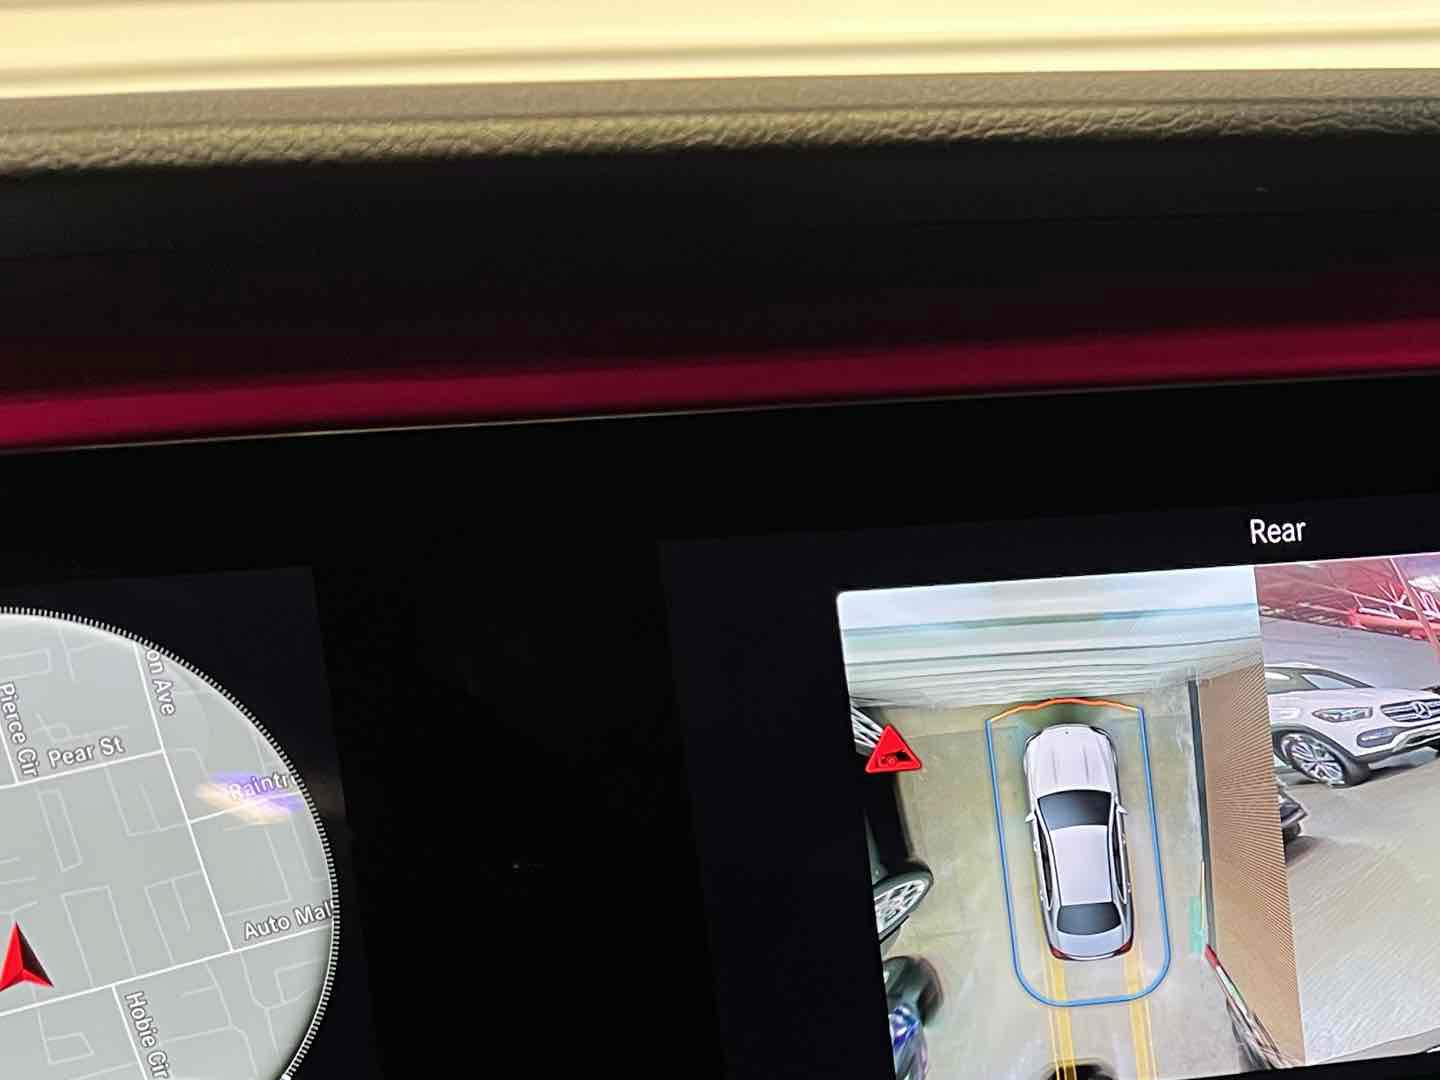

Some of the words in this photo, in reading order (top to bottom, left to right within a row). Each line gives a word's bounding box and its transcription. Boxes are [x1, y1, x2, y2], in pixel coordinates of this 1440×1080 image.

[1249, 518, 1307, 545] Rear
[144, 647, 165, 675] on
[152, 679, 176, 716] Ave
[0, 682, 27, 744] Pierce
[17, 748, 39, 777] Cir
[47, 744, 95, 768] Pear
[99, 736, 125, 756] St
[243, 914, 291, 941] Auto
[125, 991, 158, 1048] Hobie
[147, 1051, 170, 1080] Cir
